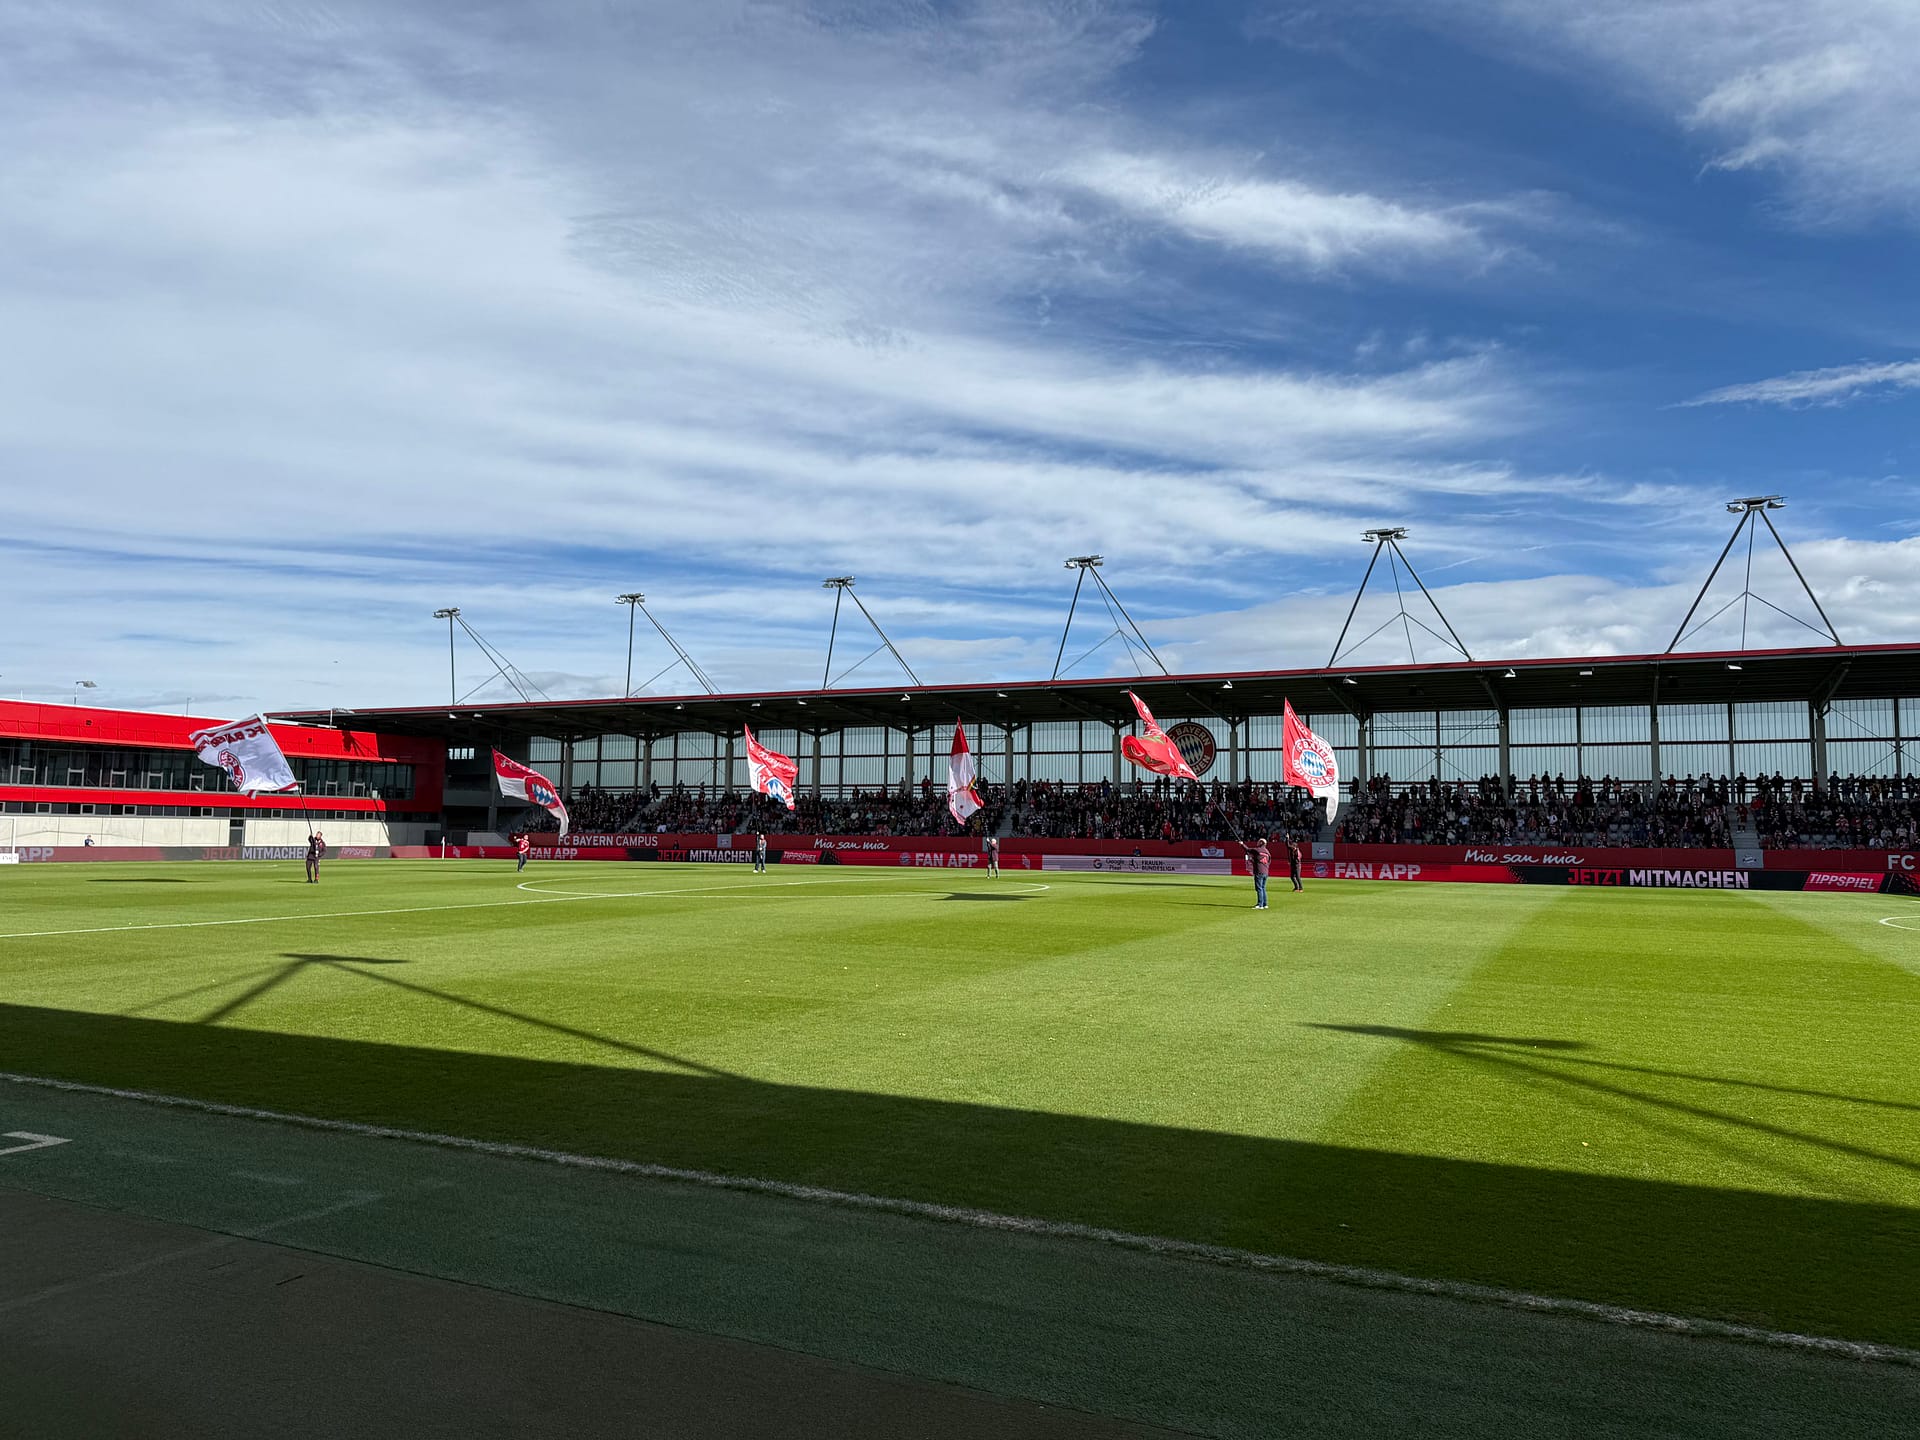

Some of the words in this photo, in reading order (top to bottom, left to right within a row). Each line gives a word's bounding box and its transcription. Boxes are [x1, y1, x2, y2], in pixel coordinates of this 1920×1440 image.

[1175, 726, 1211, 746] BAYERN
[558, 835, 570, 845] FC
[573, 835, 613, 846] BAYERN
[616, 836, 658, 847] CAMPUS
[814, 839, 835, 849] Mia
[863, 840, 889, 850] mia
[203, 848, 239, 859] JETZT
[529, 848, 551, 859] FAN
[554, 848, 577, 859] APP
[657, 850, 687, 861] JETZT
[689, 850, 752, 862] MITMACHEN
[915, 853, 943, 866] FAN
[948, 853, 978, 867] APP
[1465, 849, 1497, 862] Mia
[1500, 853, 1539, 863] san
[1543, 851, 1584, 864] mia
[1887, 855, 1915, 870] FC
[1334, 863, 1373, 878] FAN
[1379, 863, 1421, 880] APP
[1567, 868, 1624, 885] JETZT
[1629, 869, 1749, 888] MITMACHEN
[1809, 873, 1875, 889] TIPPSPIEL
